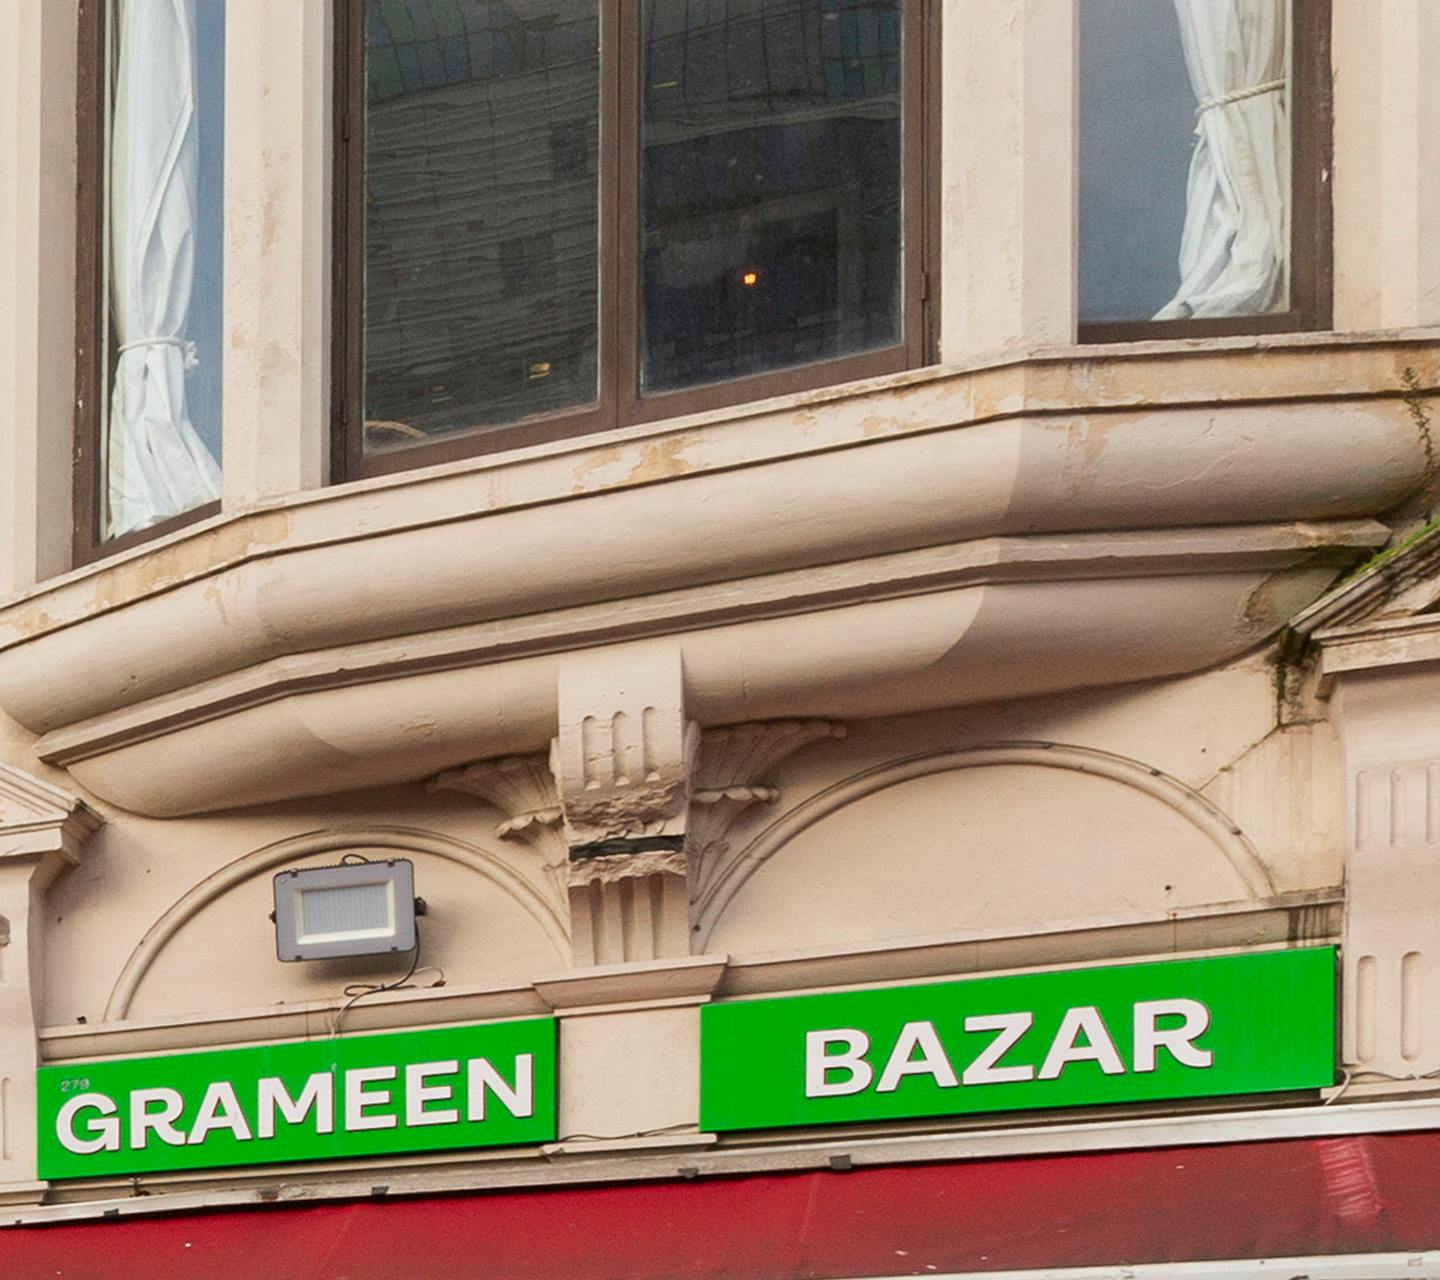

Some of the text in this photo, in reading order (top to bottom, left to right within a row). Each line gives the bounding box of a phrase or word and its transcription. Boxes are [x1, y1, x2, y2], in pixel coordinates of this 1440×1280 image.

[60, 1079, 91, 1092] 279
[805, 998, 1213, 1098] BAZAR
[55, 1052, 534, 1154] GRAMEEN
